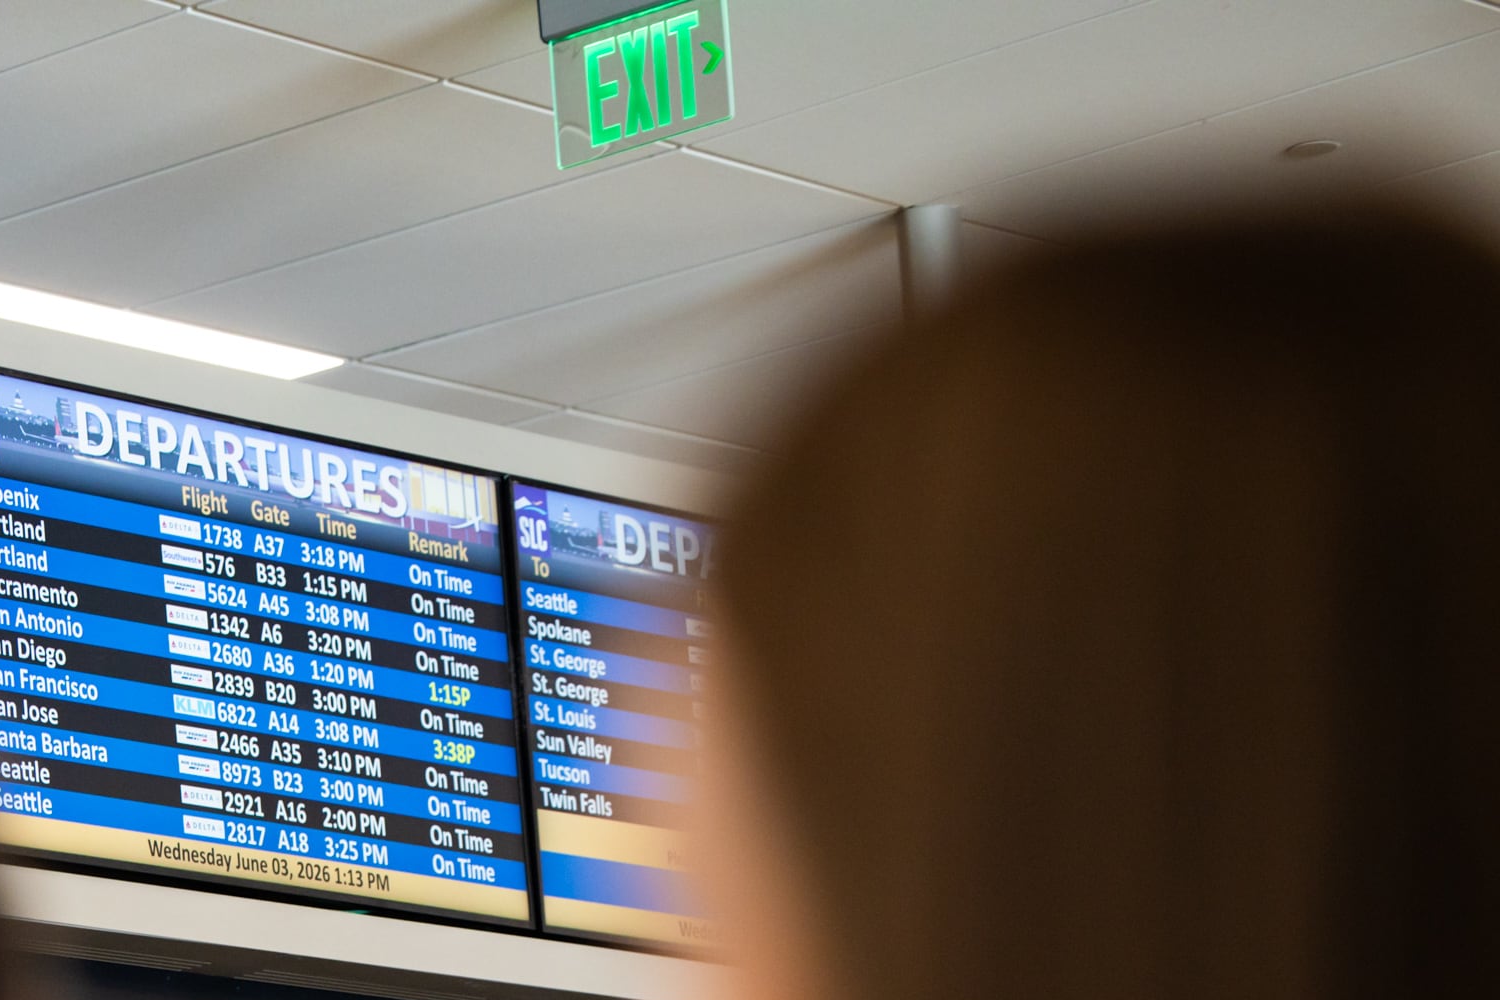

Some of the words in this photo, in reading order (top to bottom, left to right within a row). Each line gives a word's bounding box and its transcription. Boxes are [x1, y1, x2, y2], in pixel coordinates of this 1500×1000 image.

[583, 10, 699, 148] EXIT
[75, 401, 407, 518] DEPARTURES
[181, 485, 229, 516] Flight
[250, 499, 290, 527] Gate
[315, 512, 357, 540] Time
[408, 530, 469, 562] Remark
[518, 515, 549, 553] SLC
[163, 550, 198, 564] Southwest
[205, 552, 236, 578] 576
[255, 562, 287, 587] B33
[168, 521, 192, 533] DELTA
[203, 523, 243, 550] 1738
[253, 533, 285, 558] A37
[300, 542, 336, 568] 3:18
[338, 549, 365, 574] PM
[408, 563, 432, 587] On
[433, 568, 473, 595] Time
[531, 555, 550, 578] To
[526, 586, 578, 615] Seattle
[15, 607, 84, 639] Antonio
[528, 615, 592, 646] Spokane
[17, 637, 67, 669] Diego
[530, 644, 551, 666] St.
[554, 648, 607, 677] George
[532, 672, 553, 694] St.
[555, 676, 608, 706] George
[19, 668, 99, 701] Francisco
[174, 696, 213, 716] KLM
[217, 701, 258, 728] 6822
[268, 710, 300, 735] A14
[315, 718, 350, 743] 3:08
[352, 724, 379, 748] PM
[433, 738, 476, 764] 3:38P
[21, 699, 59, 725] Jose
[534, 700, 555, 723] St.
[557, 704, 597, 731] Louis
[41, 732, 108, 763] Barbara
[536, 729, 566, 753] Sun
[567, 734, 612, 765] Valley
[538, 757, 591, 786] Tucson
[540, 786, 578, 811] Twin
[579, 792, 613, 818] Falls
[147, 839, 232, 873] Wednesday
[235, 852, 268, 874] June
[271, 857, 293, 881] 03,
[297, 861, 331, 883] 2026
[334, 868, 364, 888] 1:13
[367, 872, 390, 891] PM
